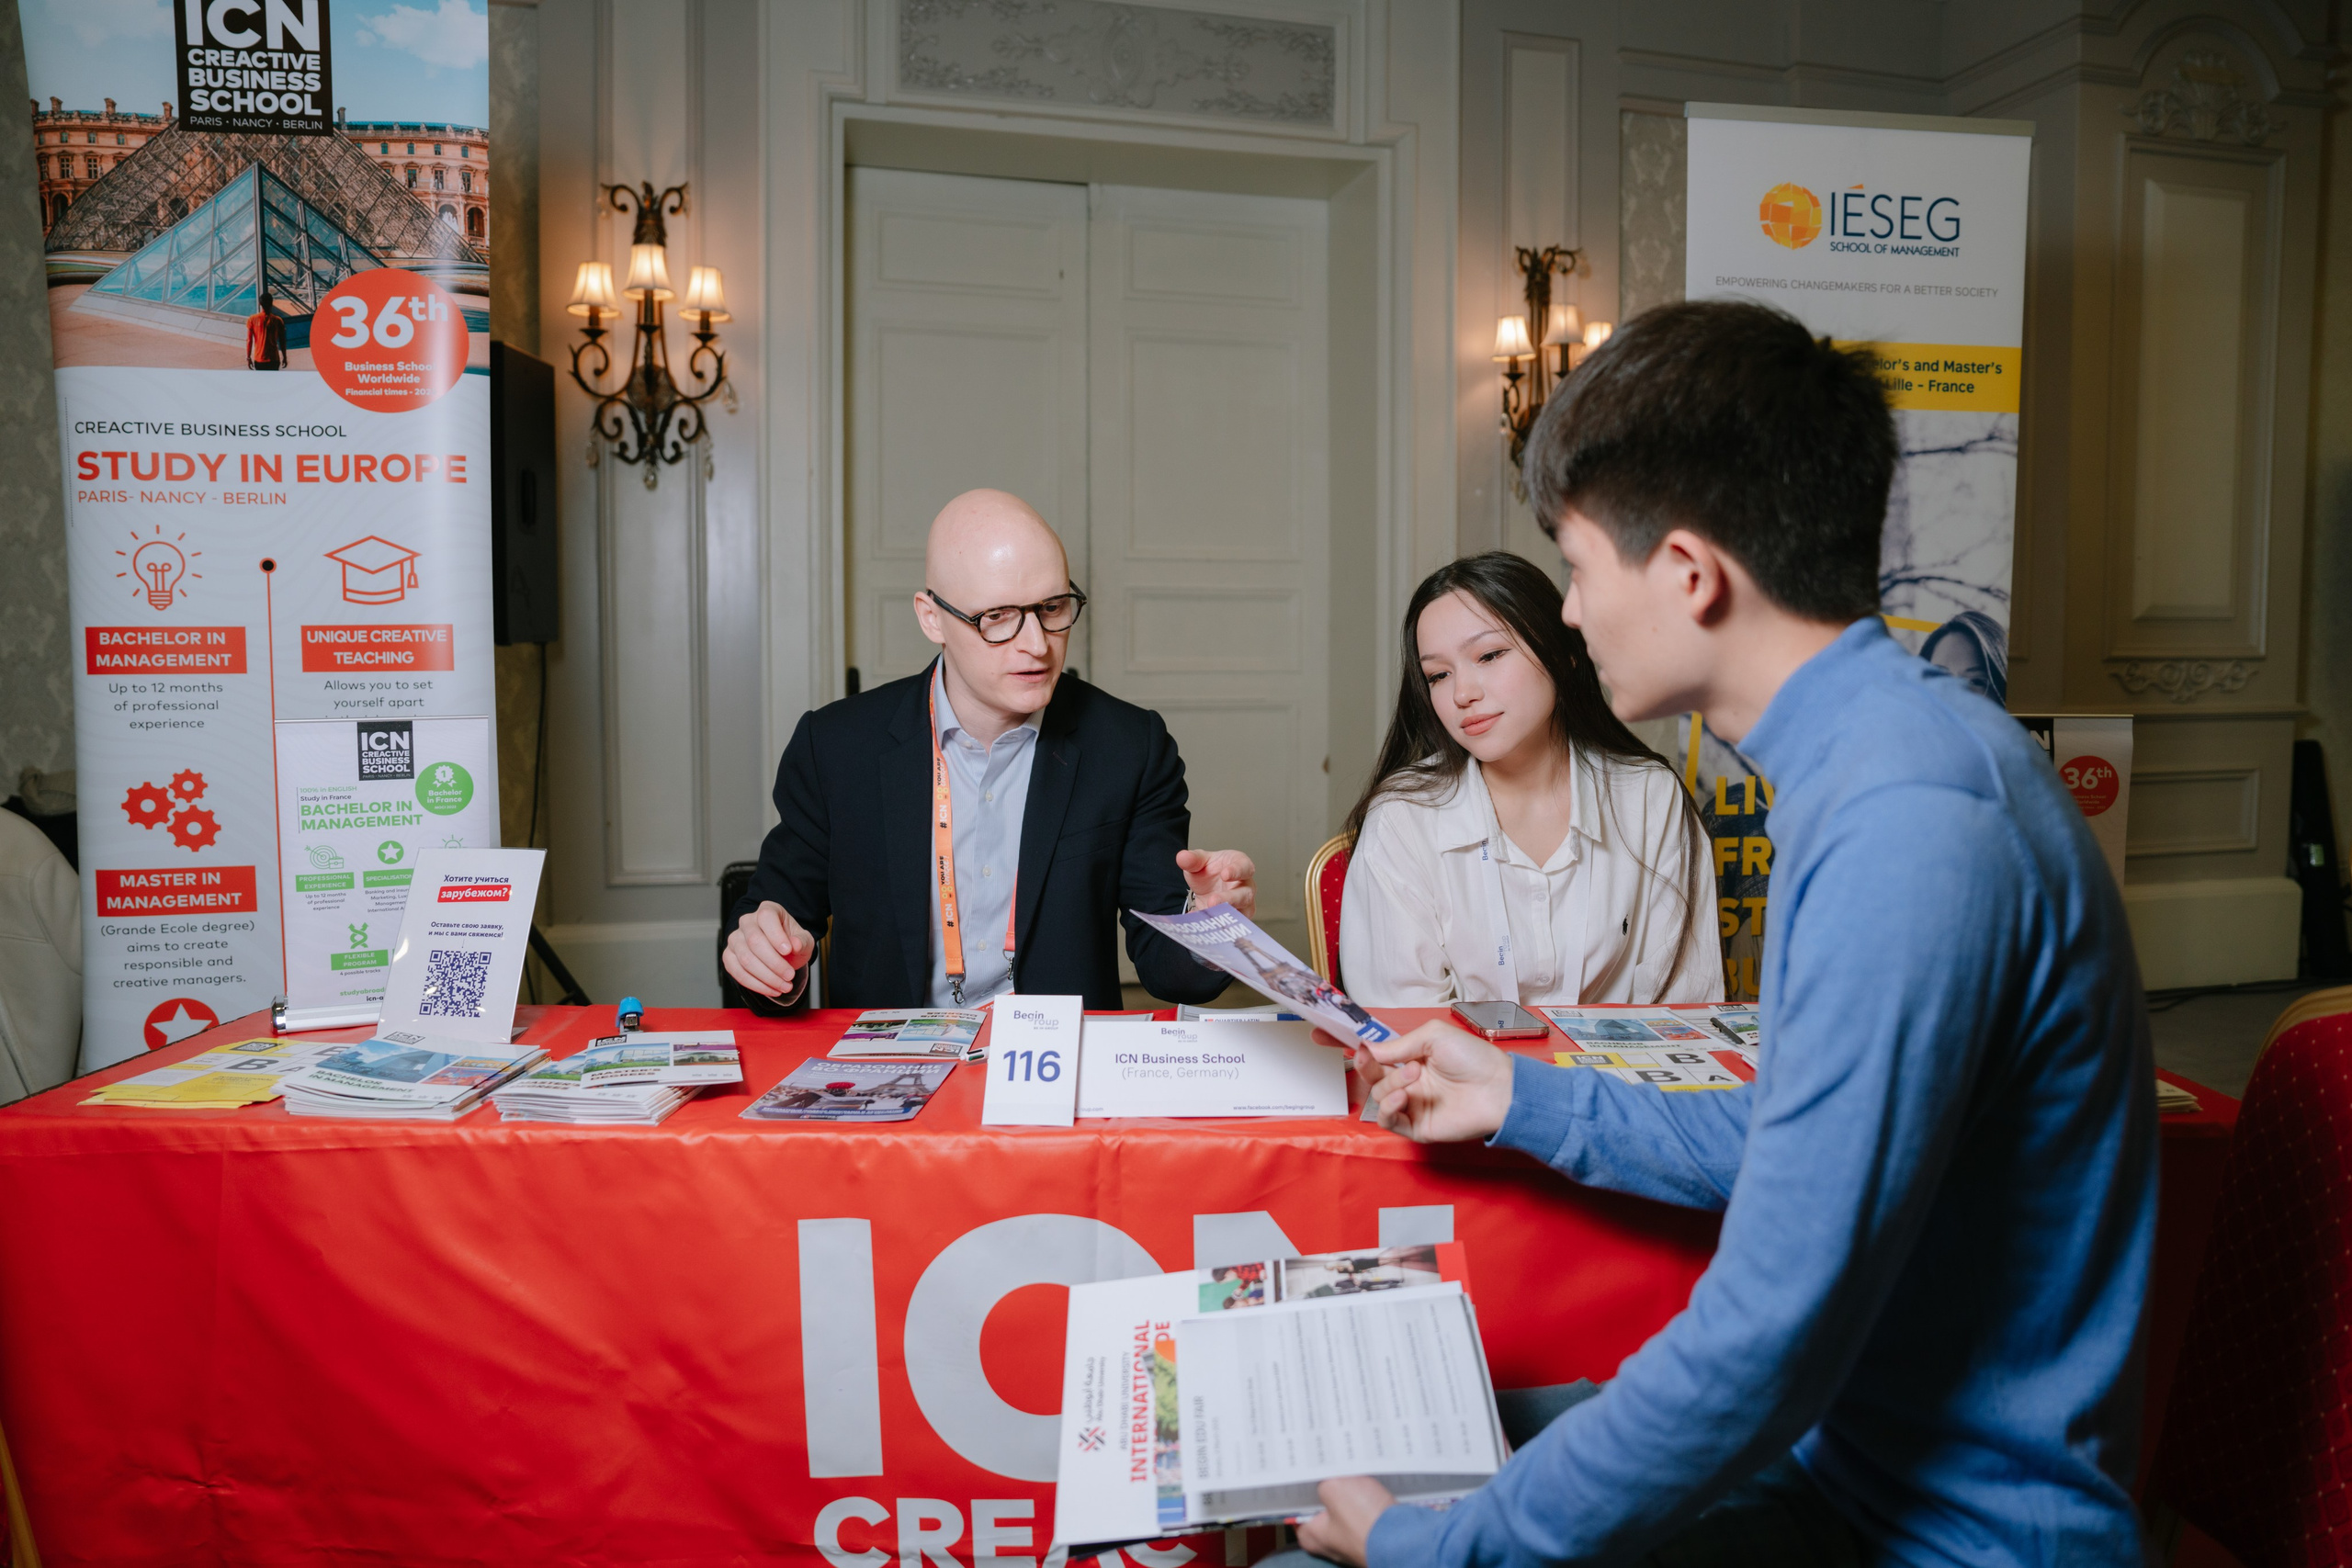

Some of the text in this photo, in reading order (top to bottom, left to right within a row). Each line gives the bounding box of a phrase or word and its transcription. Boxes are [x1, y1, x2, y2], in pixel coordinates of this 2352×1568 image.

[186, 0, 321, 51] ICN
[187, 49, 321, 71] CREACTIVE
[188, 67, 322, 92] BUSINESS
[190, 88, 322, 116] SCHOOL
[190, 116, 322, 130] PARIS NANCY BERLIN
[1829, 184, 1961, 243] IÉSEG
[1829, 241, 1960, 258] SCHOOL OF MANAGEMENT
[1715, 276, 1998, 298] EMPOWERING CHANGEMAKERS FOR A BETTER SOCIETY
[330, 294, 448, 349] 36th
[345, 361, 394, 371] Business
[1914, 360, 1939, 372] and
[1943, 360, 2003, 375] Master's
[356, 373, 421, 384] Worldwide
[1928, 379, 1974, 393] France
[345, 388, 408, 396] Financial times
[74, 421, 347, 438] CREACTIVE BUSINESS SCHOOL
[76, 450, 468, 484] STUDY IN EUROPE
[141, 491, 207, 504] NANCY
[223, 491, 287, 505] BERLIN
[99, 632, 226, 645] BACHELOR IN
[306, 629, 447, 644] UNIQUE CREATIVE
[96, 653, 232, 668] MANAGEMENT
[333, 651, 414, 665] TEACHING
[108, 682, 223, 695] Up to 12 months
[324, 680, 434, 693] Allows you to set
[114, 700, 219, 713] of professional
[334, 696, 424, 710] yourself apart
[129, 718, 205, 731] experience
[361, 730, 410, 751] ICN
[362, 757, 410, 765] BUSINESS
[363, 764, 411, 773] SCHOOL
[2064, 766, 2112, 789] 36th
[300, 800, 413, 816] BACHELOR IN
[301, 814, 423, 830] MANAGEMENT
[939, 805, 947, 829] #ICN
[119, 872, 220, 887] MASTER IN
[444, 874, 473, 883] Хотите
[107, 893, 242, 909] MANAGEMENT
[441, 887, 508, 900] зарубежом?
[944, 903, 955, 928] #ICN
[101, 920, 254, 936] (Grande Ecole degree)
[127, 940, 229, 953] aims to create
[124, 955, 233, 972] responsible and
[113, 975, 246, 988] creative managers.
[340, 987, 385, 997] studyabroad
[1013, 1010, 1044, 1021] Begin
[1160, 1028, 1185, 1036] Begin
[225, 1058, 279, 1070] B
[1003, 1050, 1061, 1082] 116
[1115, 1053, 1245, 1064] ICN Business School
[316, 1070, 383, 1085] BACHELOR
[1122, 1066, 1239, 1080] (France, Germany)
[319, 1077, 415, 1093] MANAGEMENT
